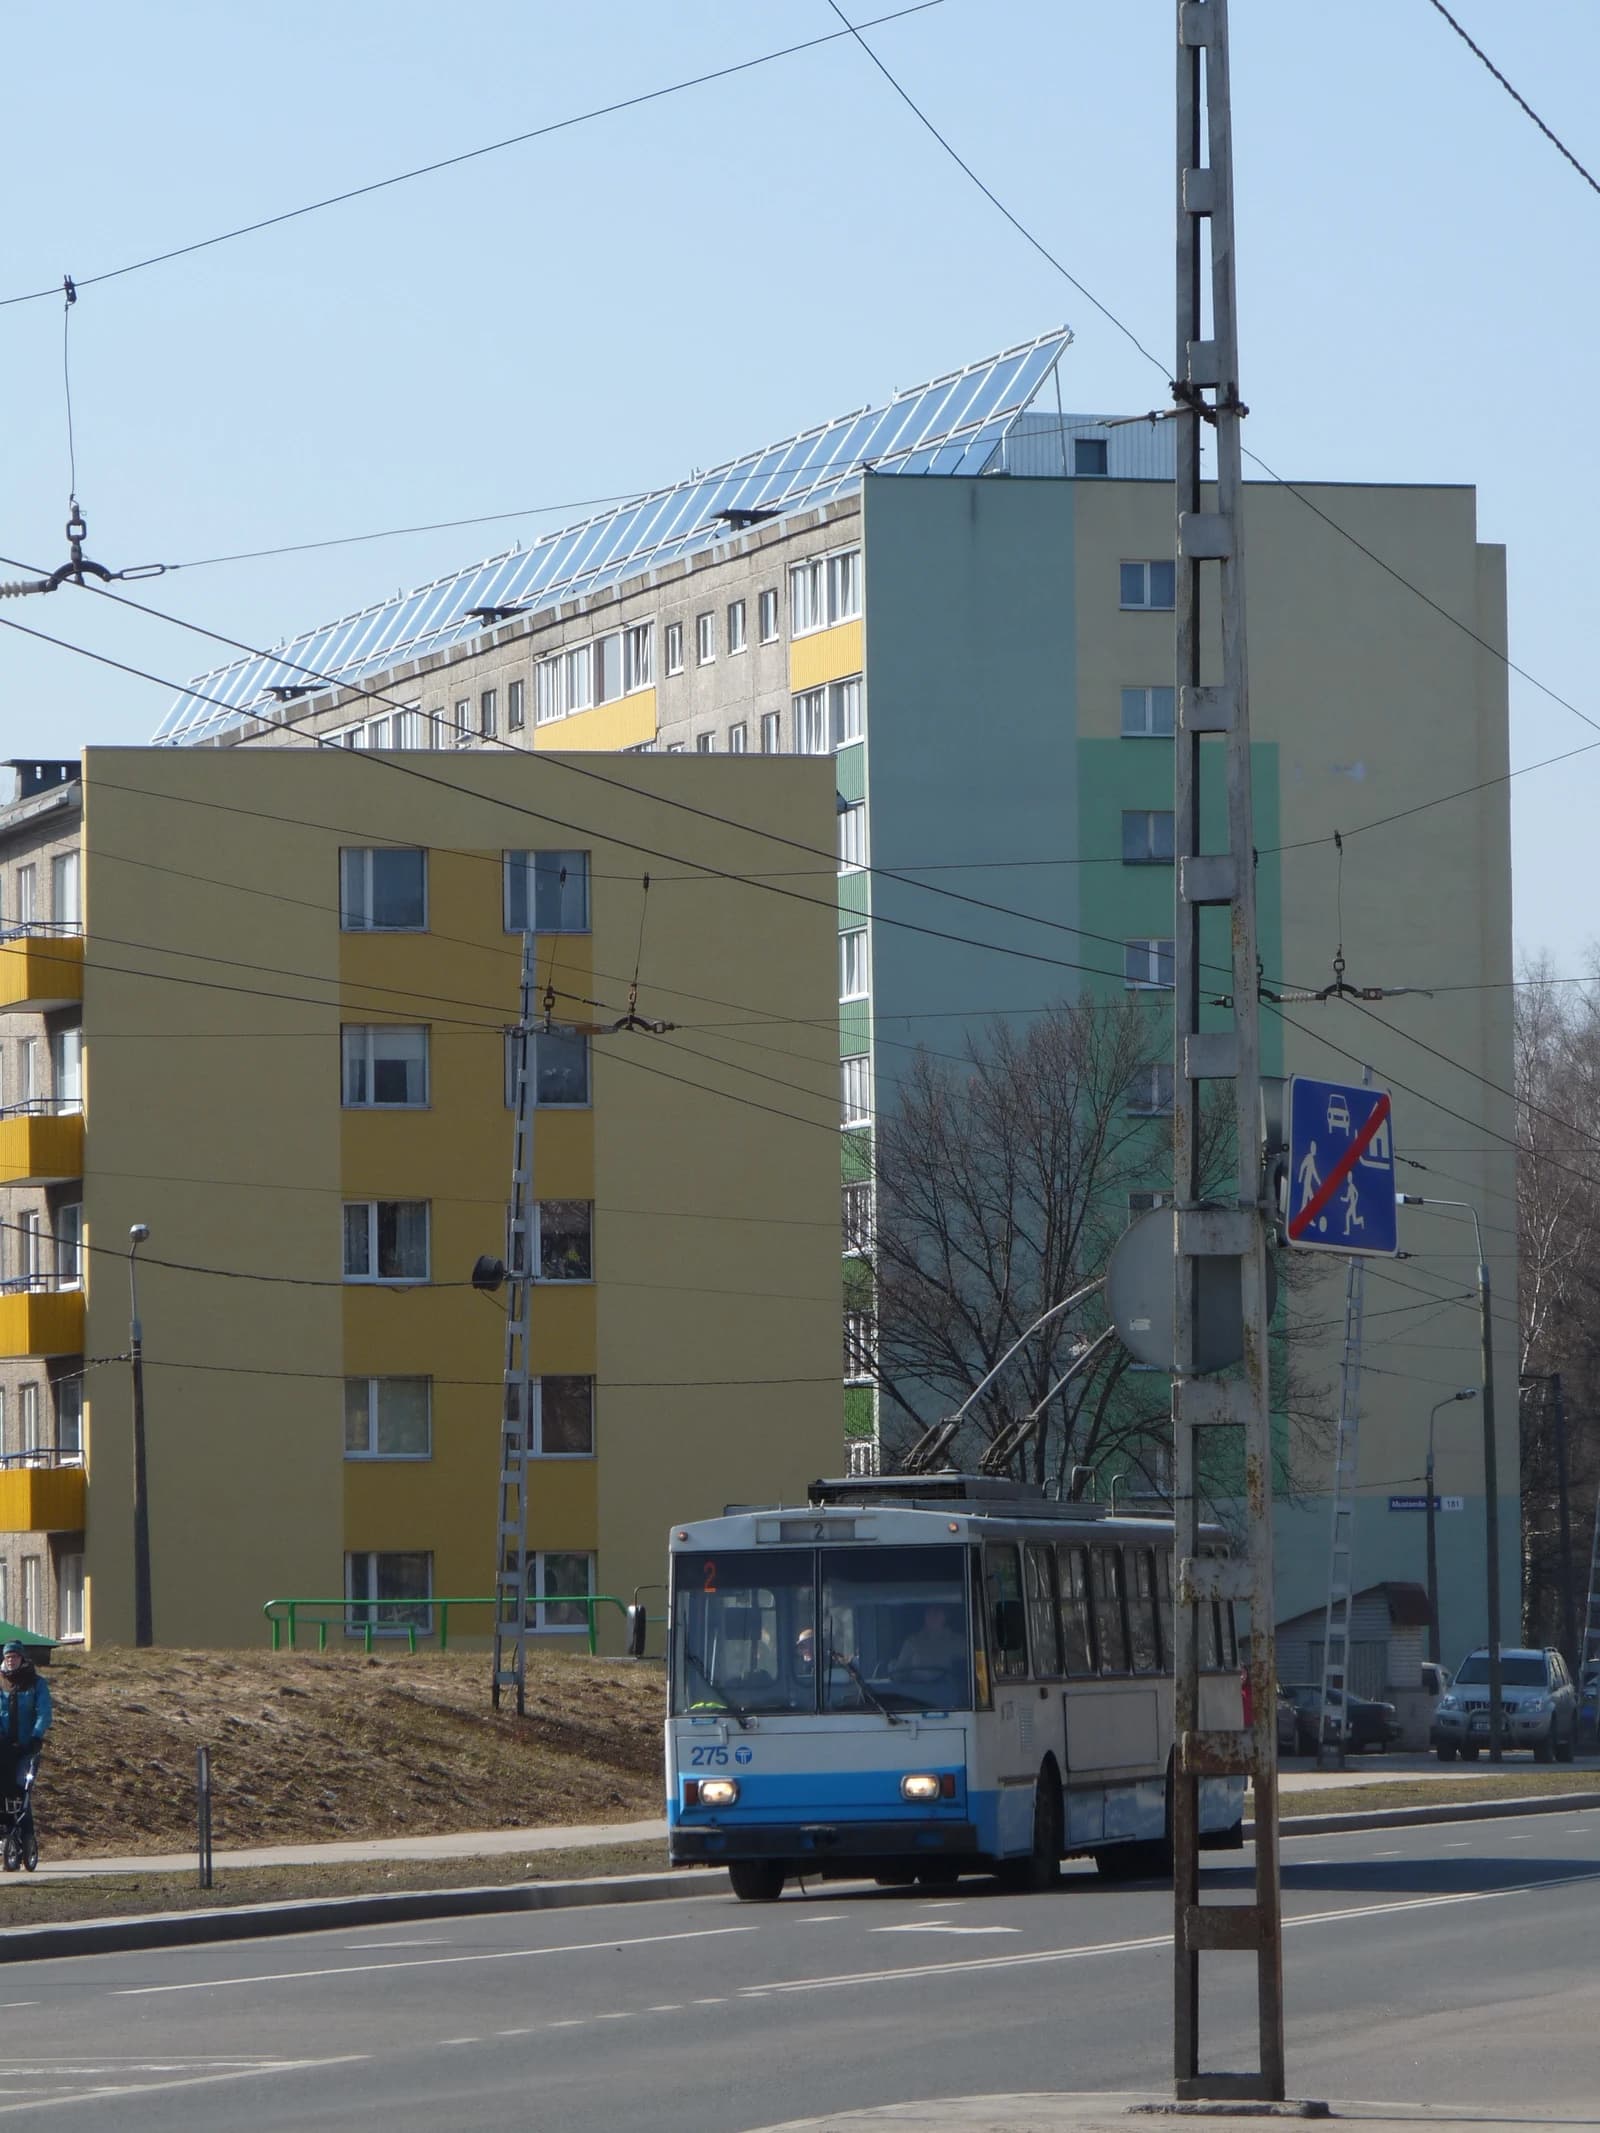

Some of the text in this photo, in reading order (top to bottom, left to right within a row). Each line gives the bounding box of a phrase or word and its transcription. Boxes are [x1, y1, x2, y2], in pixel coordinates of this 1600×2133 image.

[1447, 1499, 1460, 1509] 181
[814, 1521, 825, 1540] 2
[703, 1560, 717, 1593] 2
[690, 1745, 729, 1766] 275
